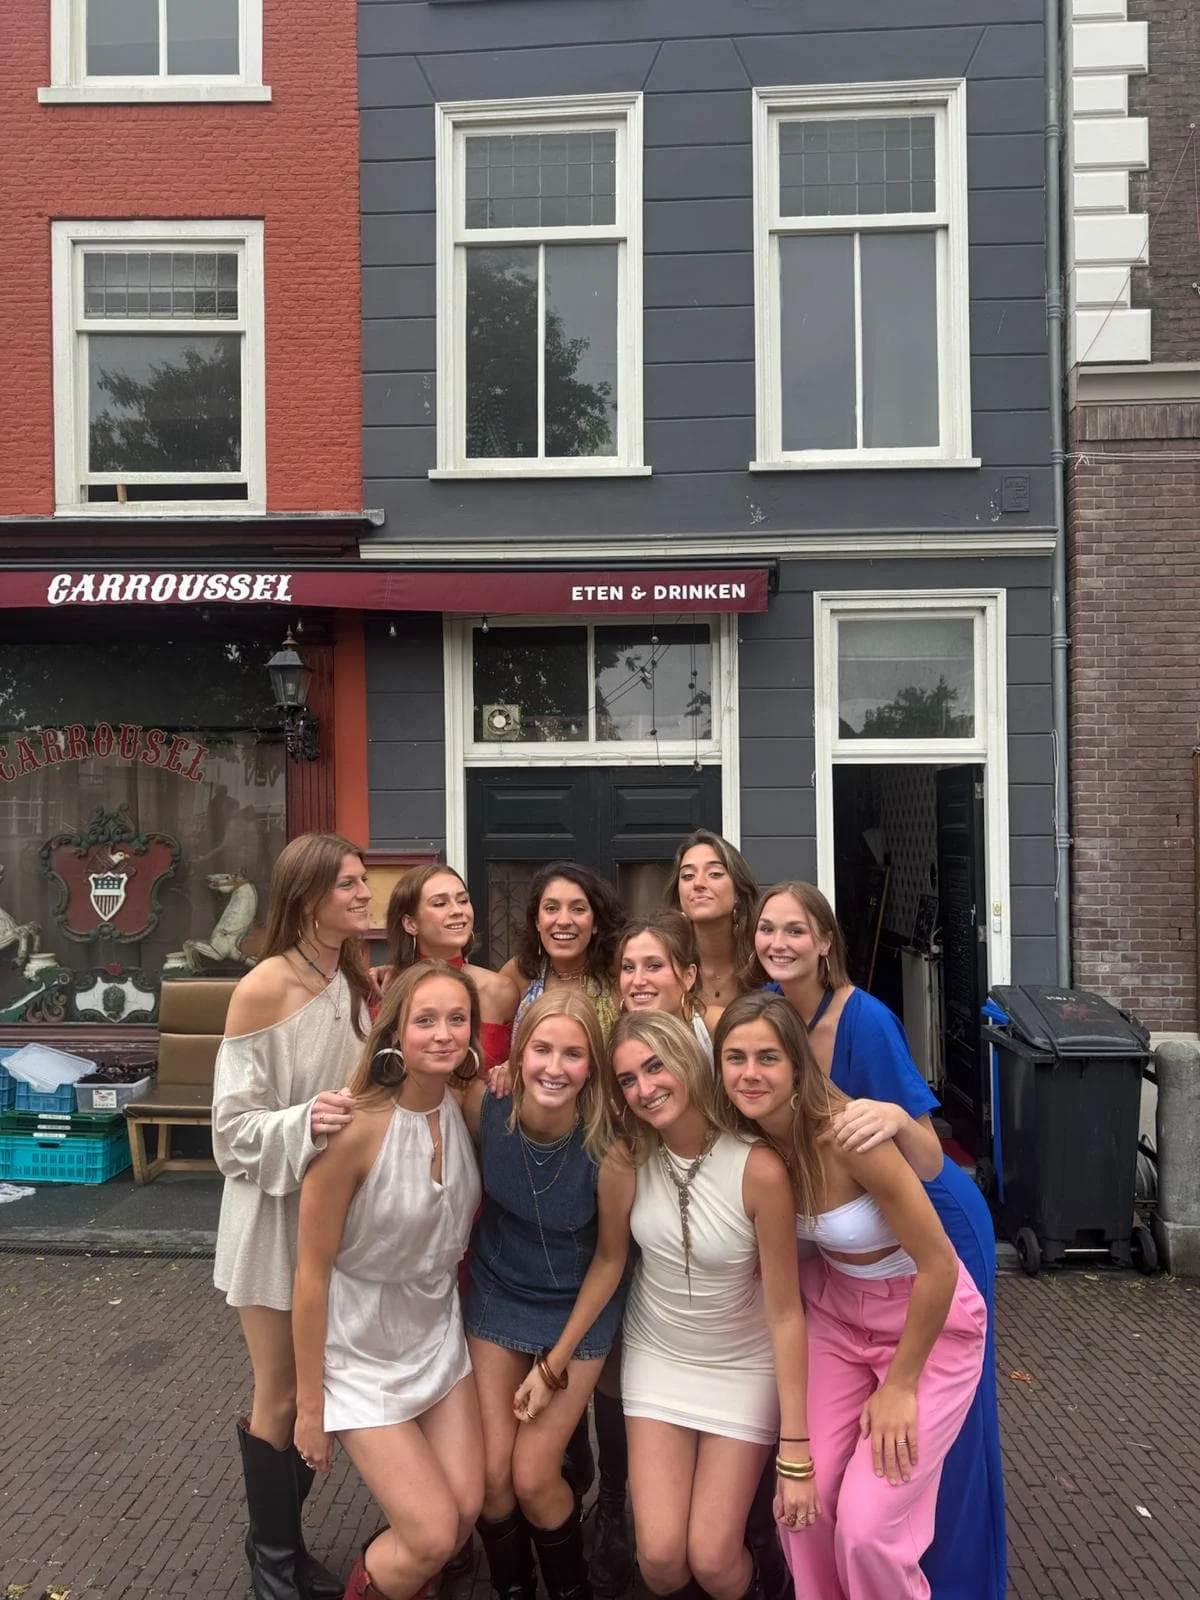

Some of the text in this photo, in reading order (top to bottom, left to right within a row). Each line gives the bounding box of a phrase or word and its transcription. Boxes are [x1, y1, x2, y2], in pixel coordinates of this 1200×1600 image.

[47, 574, 292, 604] CARROUSSEL
[571, 583, 746, 601] ETEN & DRINKEN
[0, 721, 209, 782] CARROUSEL
